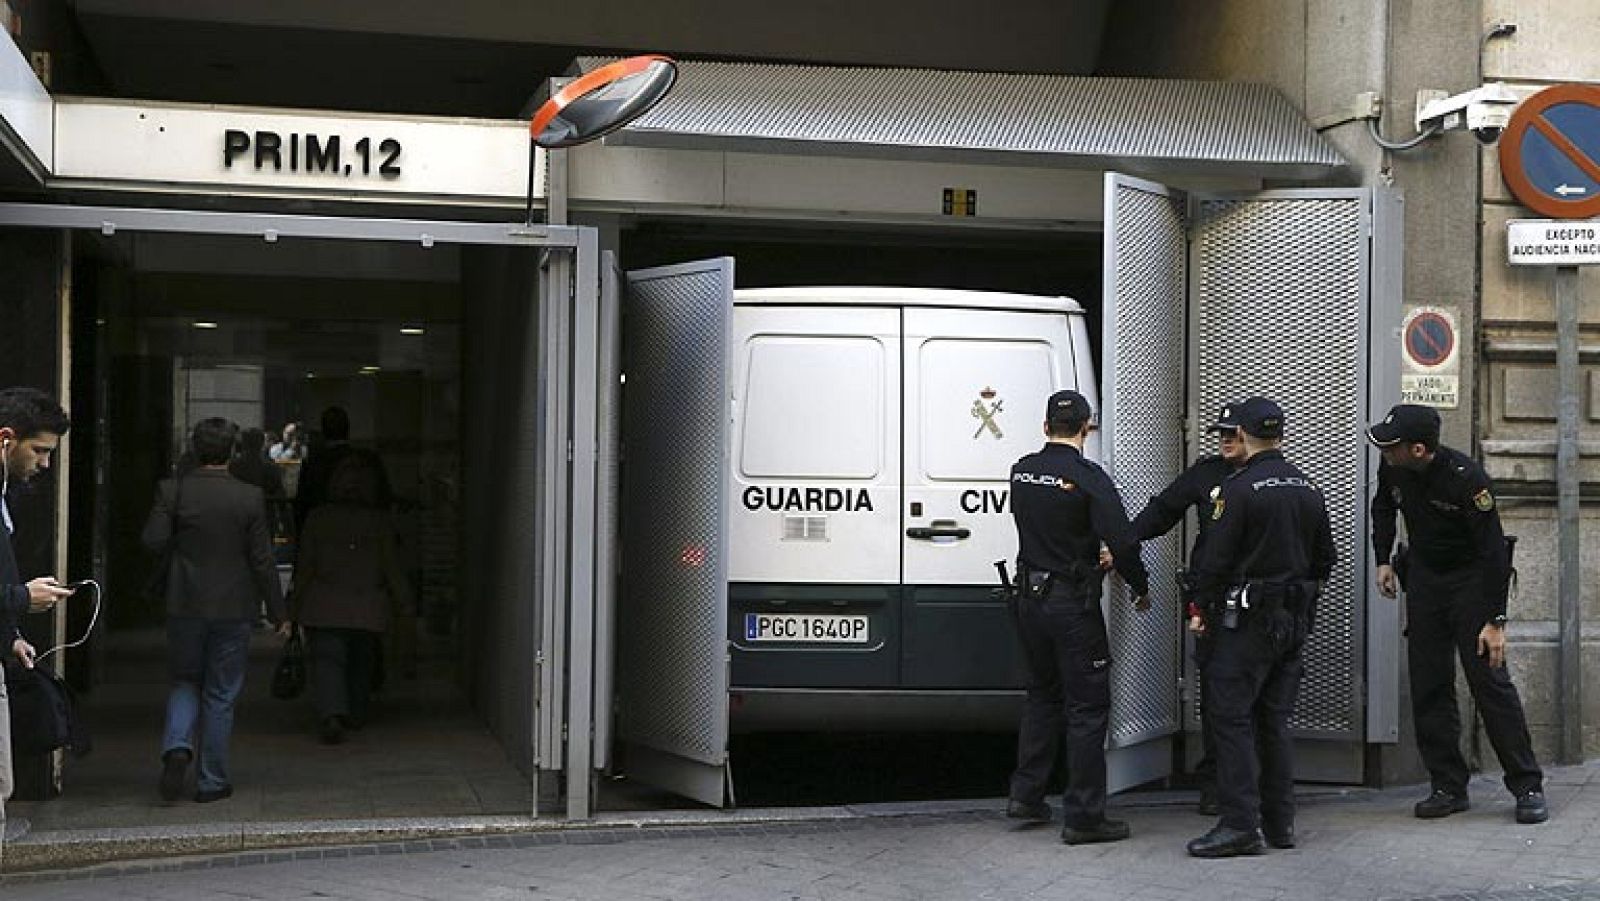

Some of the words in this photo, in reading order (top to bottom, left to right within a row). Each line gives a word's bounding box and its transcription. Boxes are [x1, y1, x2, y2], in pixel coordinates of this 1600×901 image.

[224, 128, 402, 178] PRIM,12
[1546, 229, 1595, 241] EXCEPTO
[1513, 245, 1570, 256] AUDIENCIA
[743, 485, 874, 512] GUARDIA
[960, 489, 1014, 514] CIV
